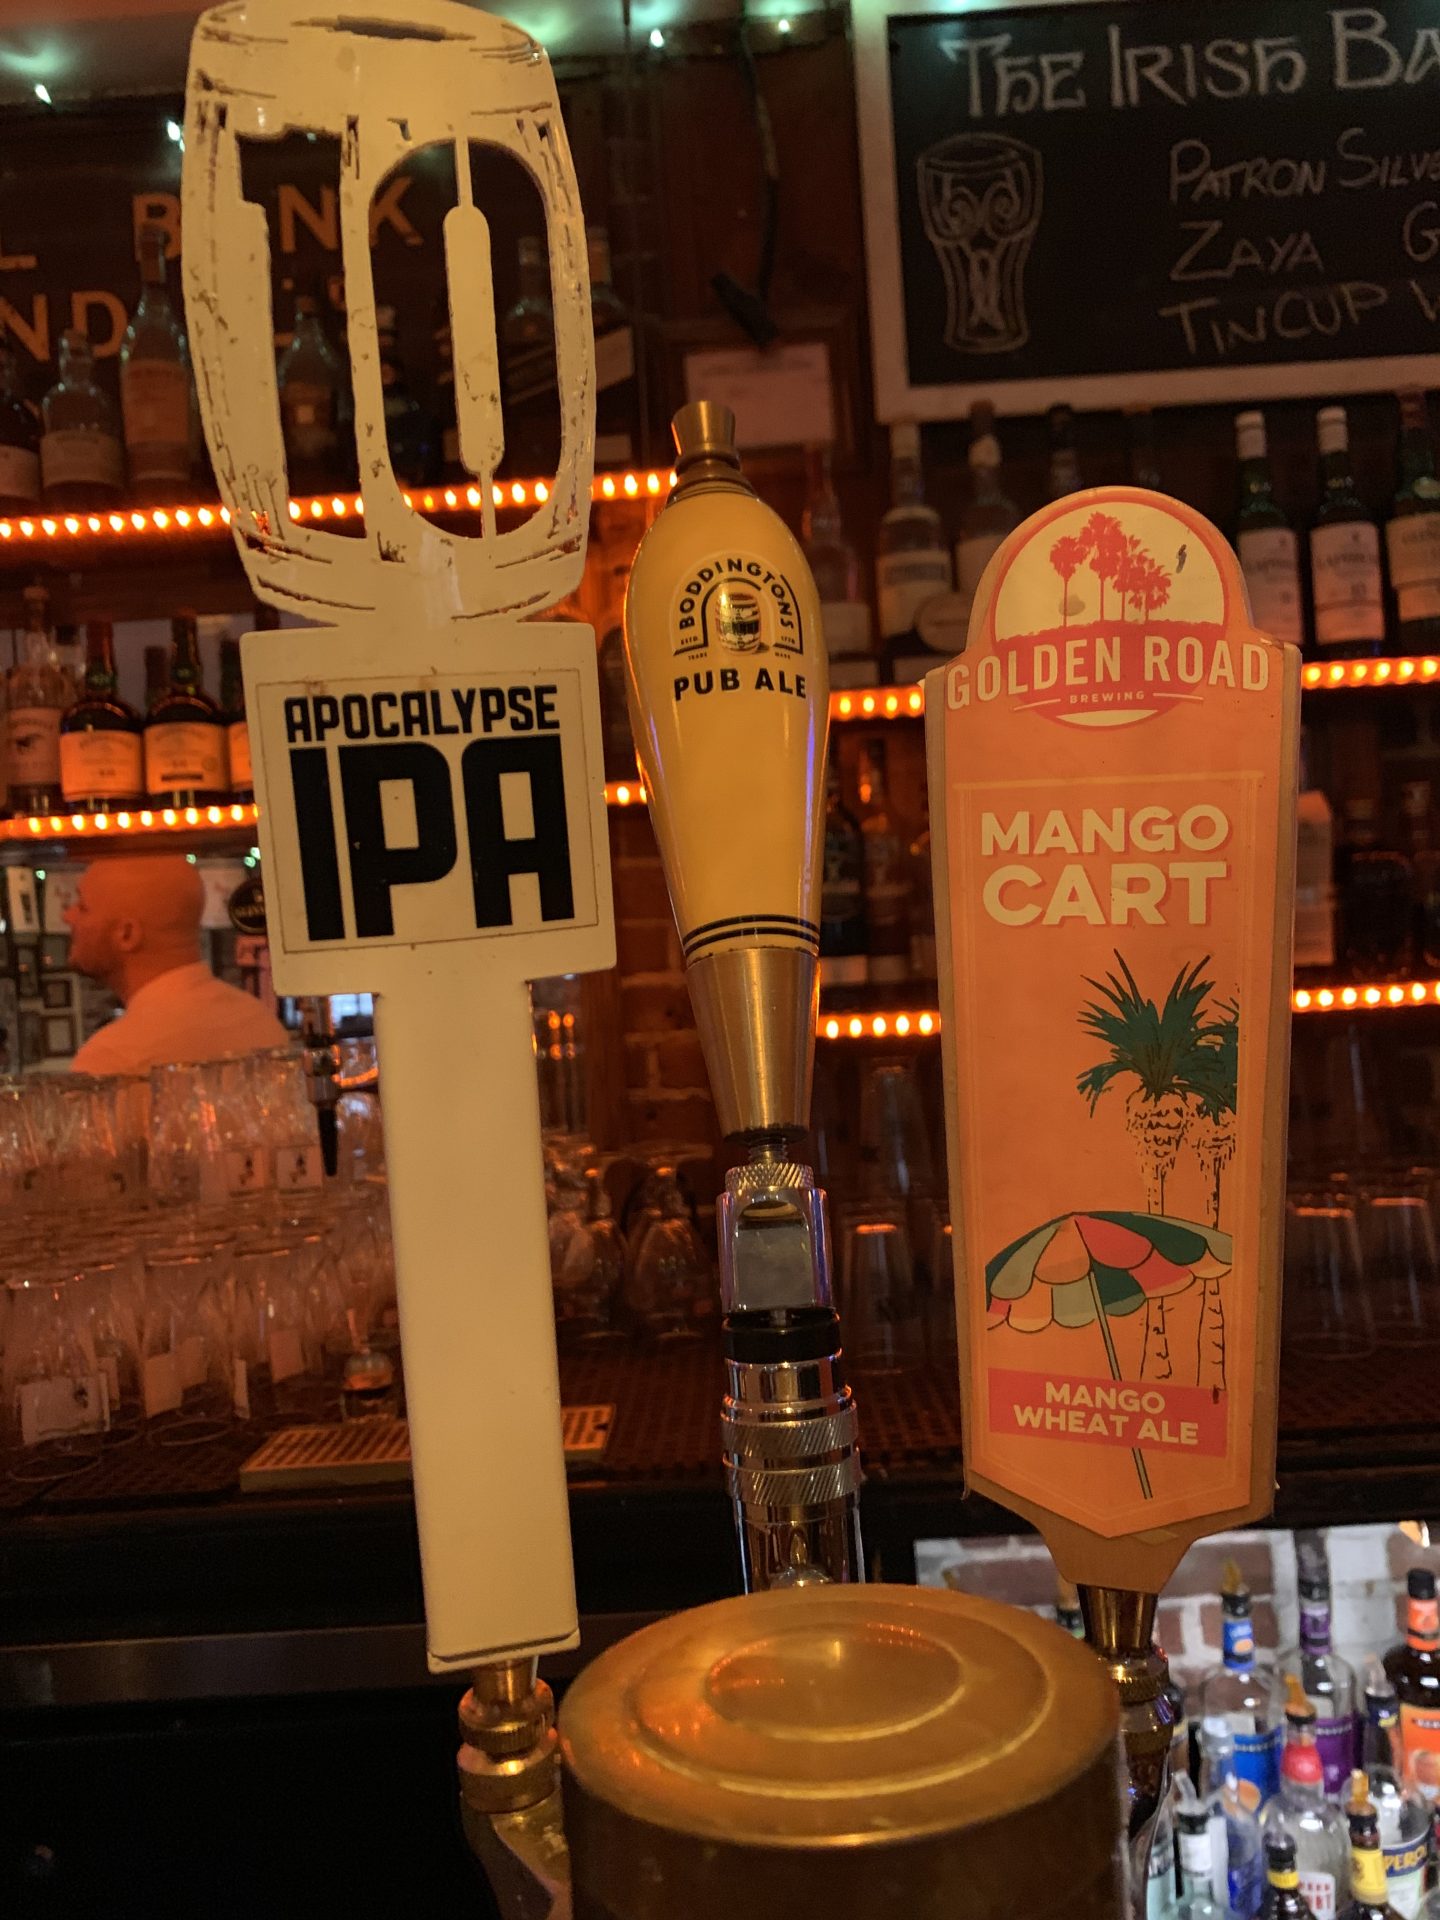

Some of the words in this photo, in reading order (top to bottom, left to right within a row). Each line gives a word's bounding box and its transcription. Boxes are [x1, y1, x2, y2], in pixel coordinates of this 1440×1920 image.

[1169, 139, 1326, 205] PATRON
[132, 178, 423, 262] BNK
[1169, 219, 1324, 283] ZAYA
[1158, 280, 1389, 355] TINCUP
[678, 558, 795, 630] BODDINGTONS
[674, 668, 740, 701] PUB
[754, 667, 807, 699] ALE
[947, 636, 1122, 711] GOLDEN
[1143, 634, 1270, 692] ROAD
[1069, 690, 1146, 705] BREWING
[284, 685, 561, 743] APOCALYPSE
[289, 734, 575, 941] IPA
[980, 804, 1230, 856] MANGO
[982, 860, 1228, 927] CART
[1013, 1403, 1130, 1439] WHEAT
[1136, 1418, 1199, 1446] ALE
[1044, 1381, 1166, 1415] MANGO
